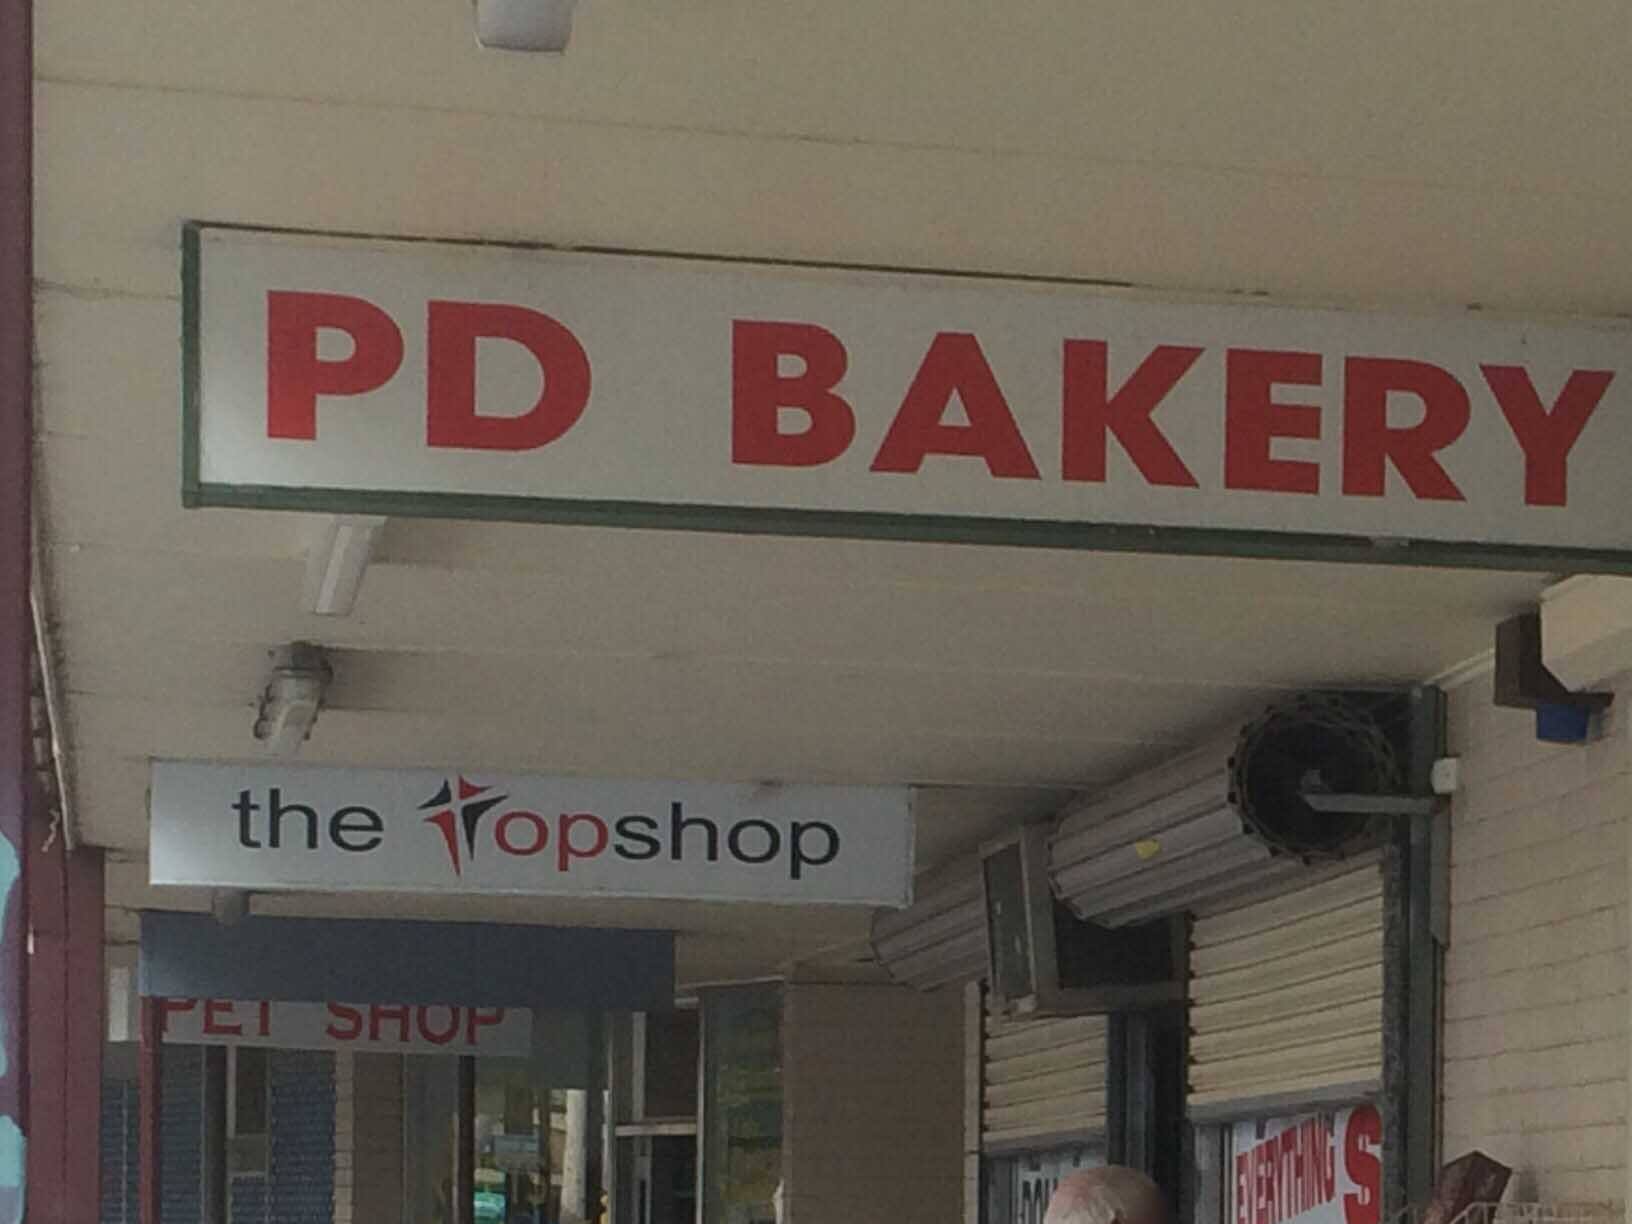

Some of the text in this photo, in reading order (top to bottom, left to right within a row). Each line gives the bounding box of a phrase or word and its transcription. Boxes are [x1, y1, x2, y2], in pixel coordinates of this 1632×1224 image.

[266, 292, 1616, 507] PD BAKERY
[231, 787, 385, 851] the
[325, 1003, 505, 1046] SHOP
